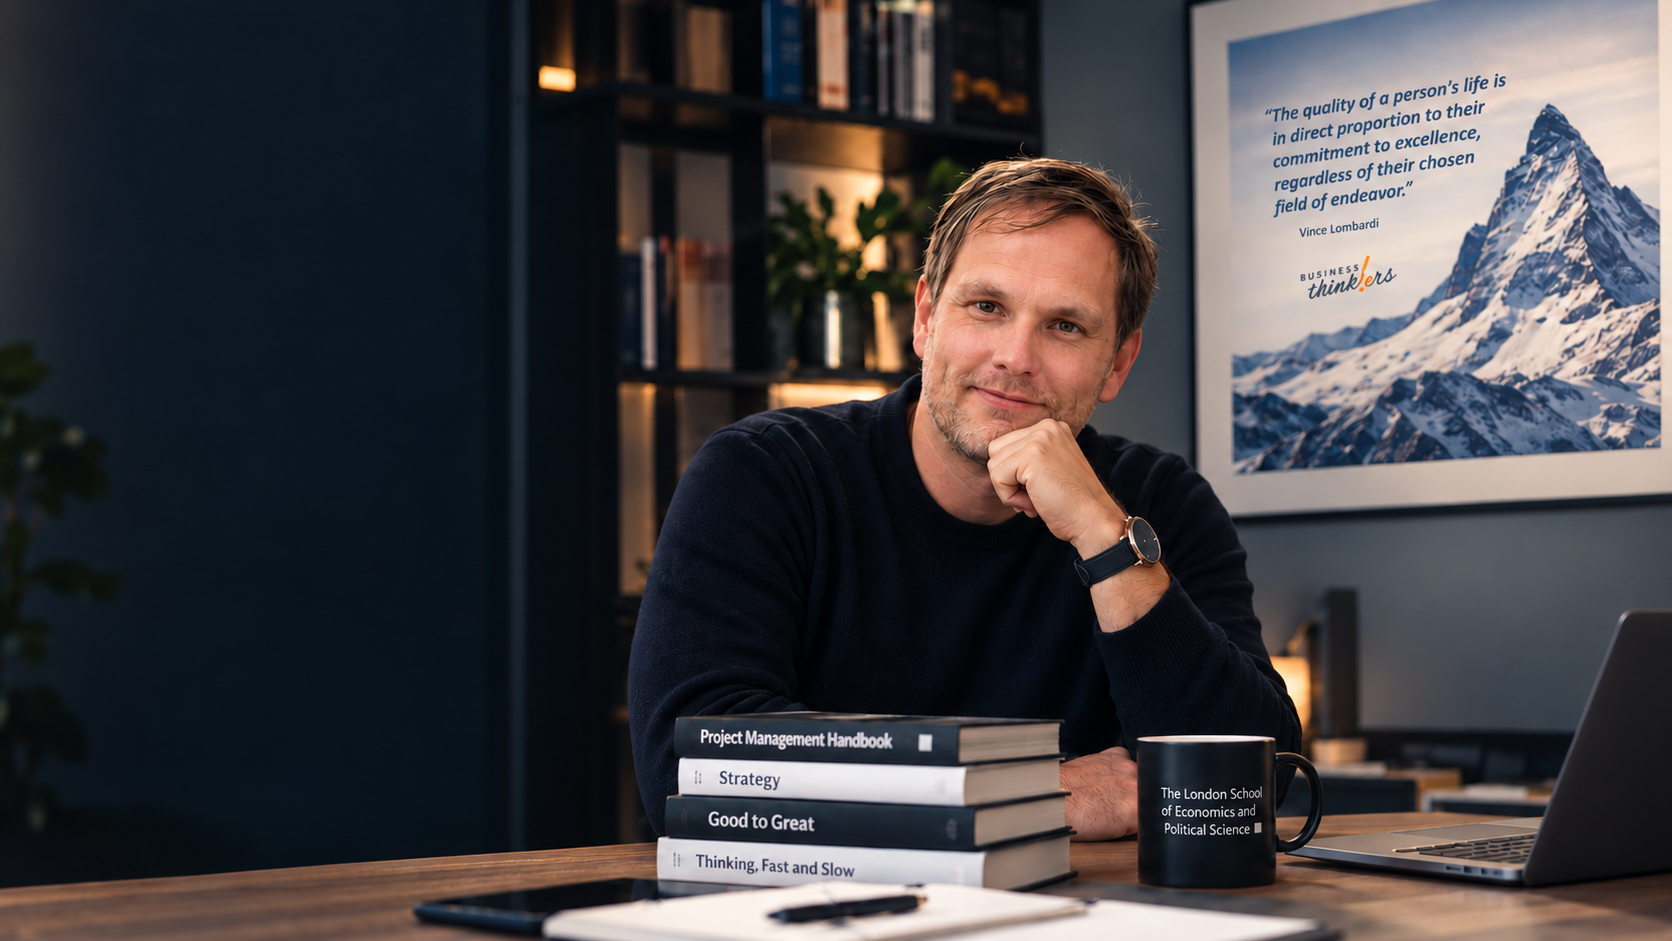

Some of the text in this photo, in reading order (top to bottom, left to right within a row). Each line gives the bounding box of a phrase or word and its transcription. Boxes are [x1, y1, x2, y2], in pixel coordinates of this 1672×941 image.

[1303, 98, 1355, 120] quality
[1360, 92, 1376, 110] of
[1379, 94, 1389, 105] a
[1464, 76, 1488, 95] life
[1494, 73, 1506, 87] is
[1272, 101, 1485, 145] in direct proportion to their
[1273, 126, 1481, 168] commitment to excellence,
[1274, 151, 1474, 192] regardless of their chosen
[1274, 196, 1307, 218] field
[1311, 193, 1327, 211] of
[1299, 218, 1379, 237] Vince Lombardi
[1300, 264, 1359, 281] BUSINESS
[701, 729, 893, 750] Project Management Handbook
[719, 770, 780, 791] Strategy
[1161, 786, 1262, 800] The London School
[1162, 804, 1255, 817] of Economics and
[708, 811, 748, 829] Good
[752, 814, 768, 829] to
[771, 814, 815, 832] Great
[1165, 823, 1250, 835] Political Science
[696, 854, 759, 873] Thinking,
[762, 858, 789, 874] Fast
[792, 860, 818, 875] and
[821, 862, 855, 878] Slow
